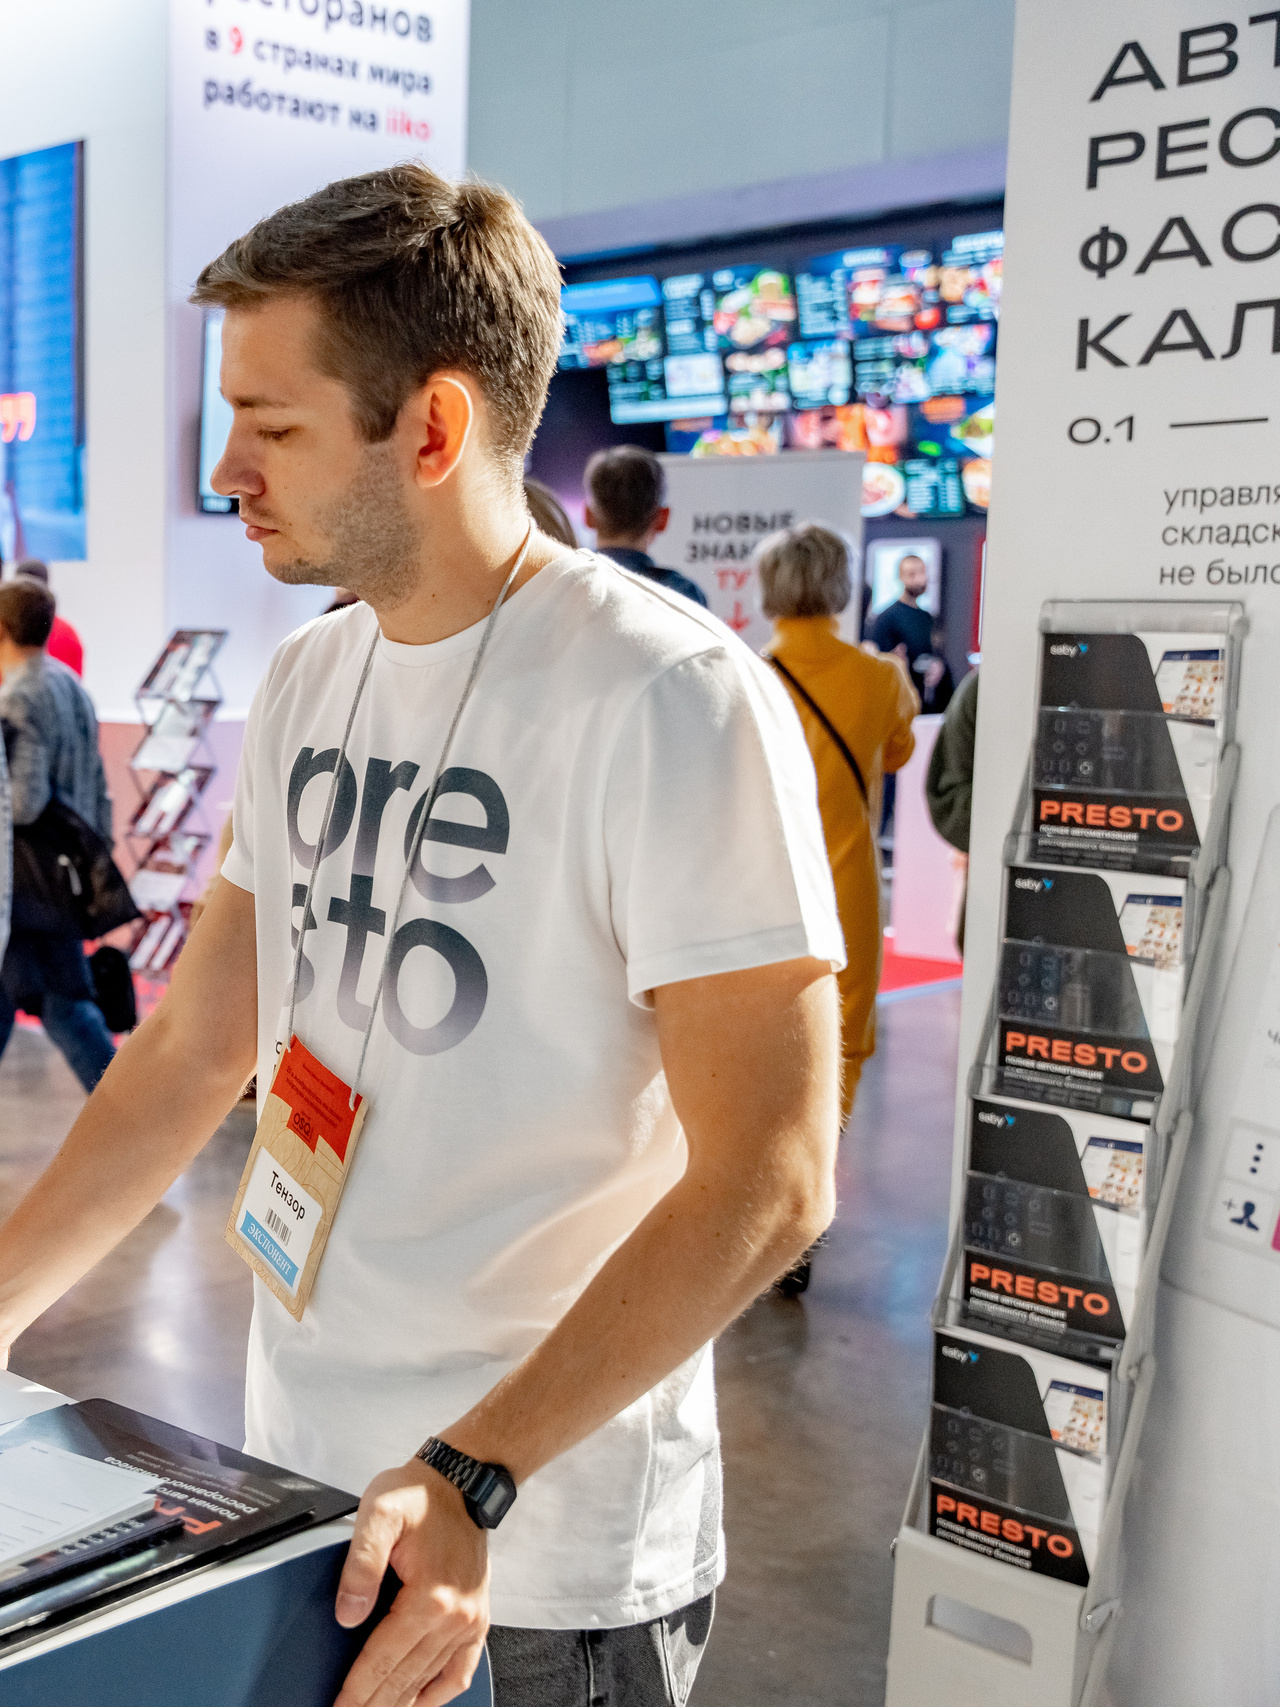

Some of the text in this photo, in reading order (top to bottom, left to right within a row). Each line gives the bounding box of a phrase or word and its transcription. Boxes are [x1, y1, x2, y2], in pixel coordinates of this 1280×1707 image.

[206, 0, 432, 42] оранов
[206, 26, 431, 97] в 9 странах мира
[204, 79, 430, 141] работают на iiko
[1076, 297, 1280, 372] КАЛ
[1068, 414, 1134, 445] 0.1
[693, 511, 793, 534] НОВЫЕ
[1159, 565, 1195, 585] не
[1050, 645, 1077, 658] saby
[286, 745, 510, 904] pre
[1040, 800, 1184, 832] PRESTO
[1015, 878, 1042, 892] saby
[1006, 1031, 1148, 1074] PRESTO
[978, 1112, 1005, 1127] saby
[271, 1171, 306, 1220] Тензор
[248, 1222, 292, 1275] ЭКСПОНЕНТ
[970, 1263, 1109, 1316] PRESTO
[942, 1346, 968, 1363] saby
[187, 1497, 241, 1521] полная
[936, 1494, 1073, 1558] PRESTO
